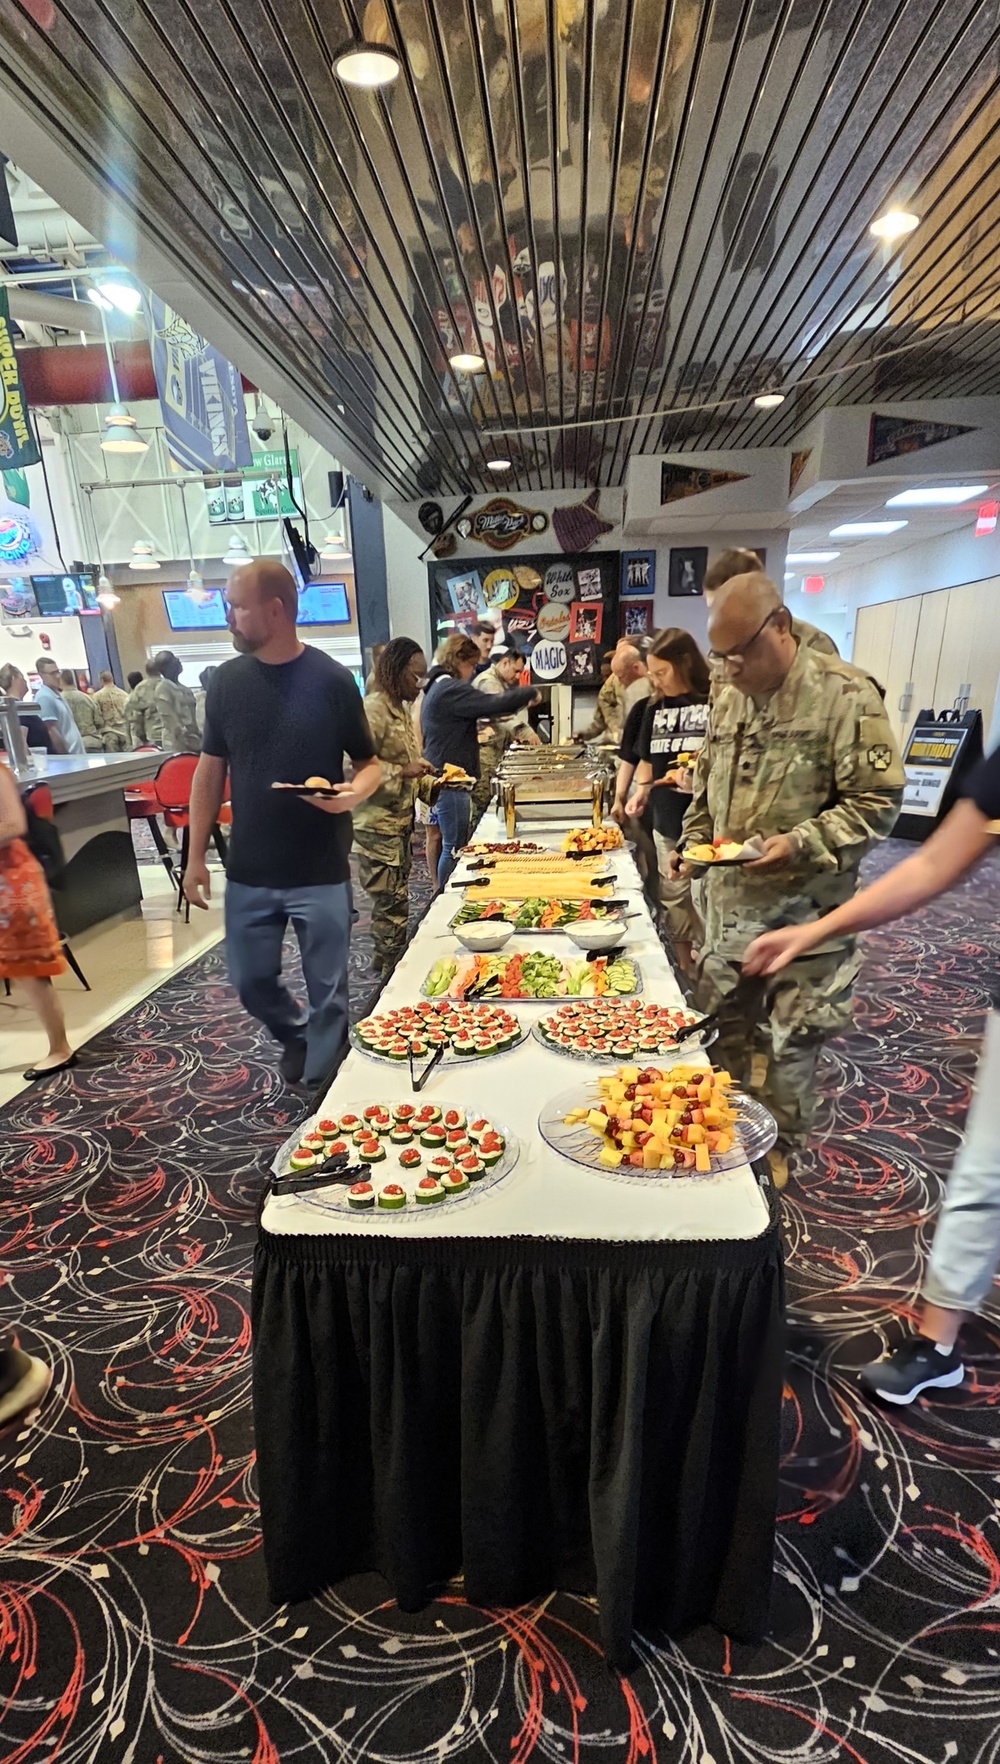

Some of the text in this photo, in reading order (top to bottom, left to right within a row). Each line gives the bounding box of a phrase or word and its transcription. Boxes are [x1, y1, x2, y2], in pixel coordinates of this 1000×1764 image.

[199, 358, 229, 457] VIKINGS
[550, 584, 571, 598] Sox
[535, 647, 566, 671] MAGIC
